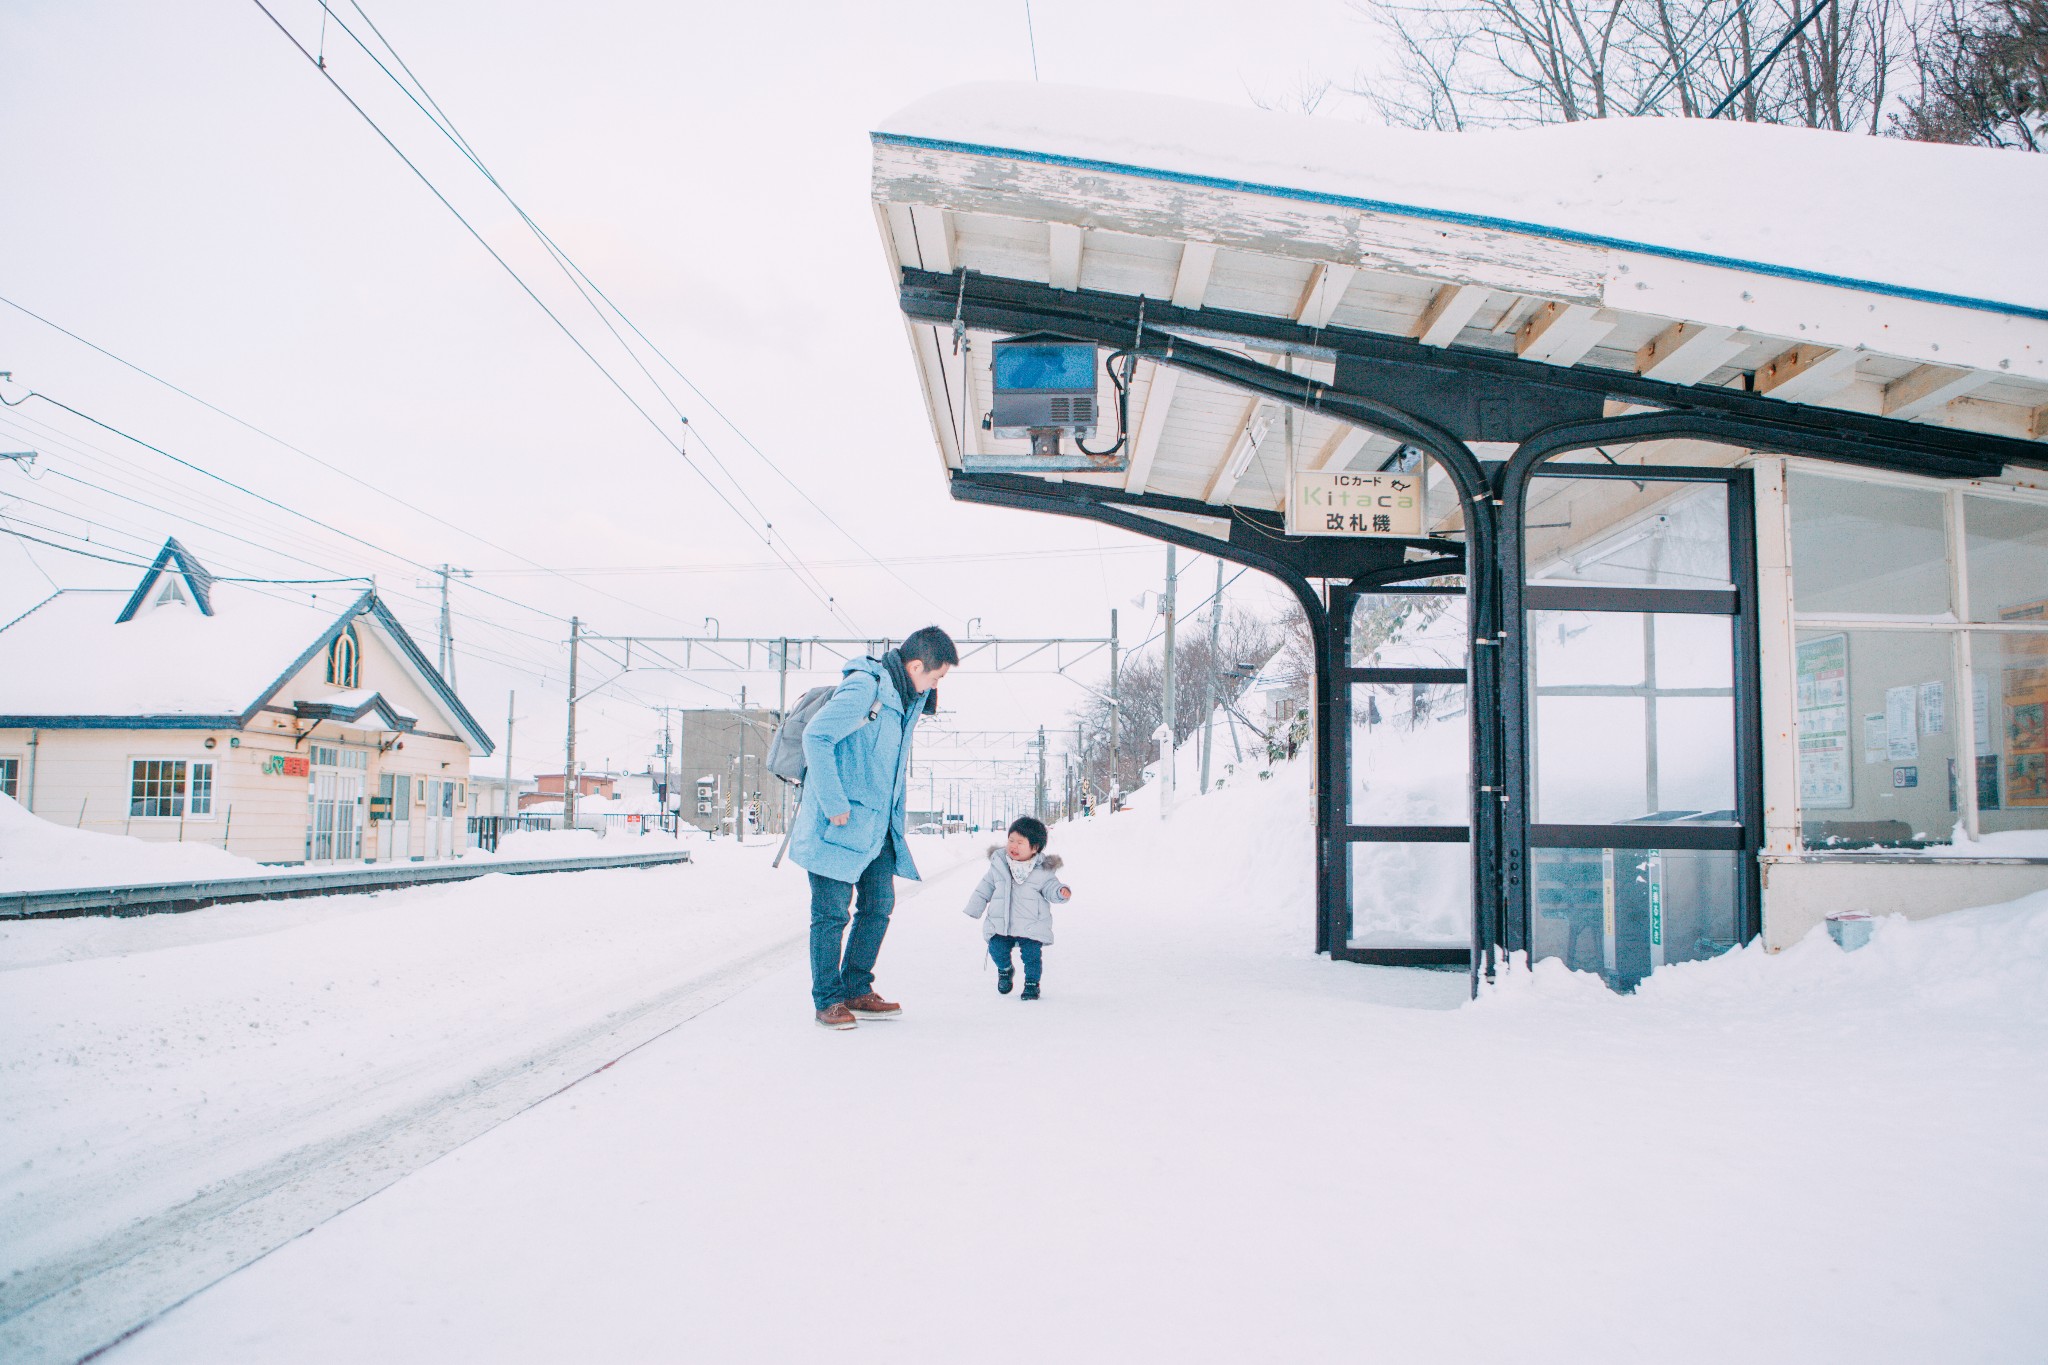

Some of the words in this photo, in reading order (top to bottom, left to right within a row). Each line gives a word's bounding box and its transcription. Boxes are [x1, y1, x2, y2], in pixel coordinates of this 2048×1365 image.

[1334, 475, 1382, 486] ICカード
[1303, 487, 1413, 509] Kitaca
[1326, 513, 1391, 532] 改札機
